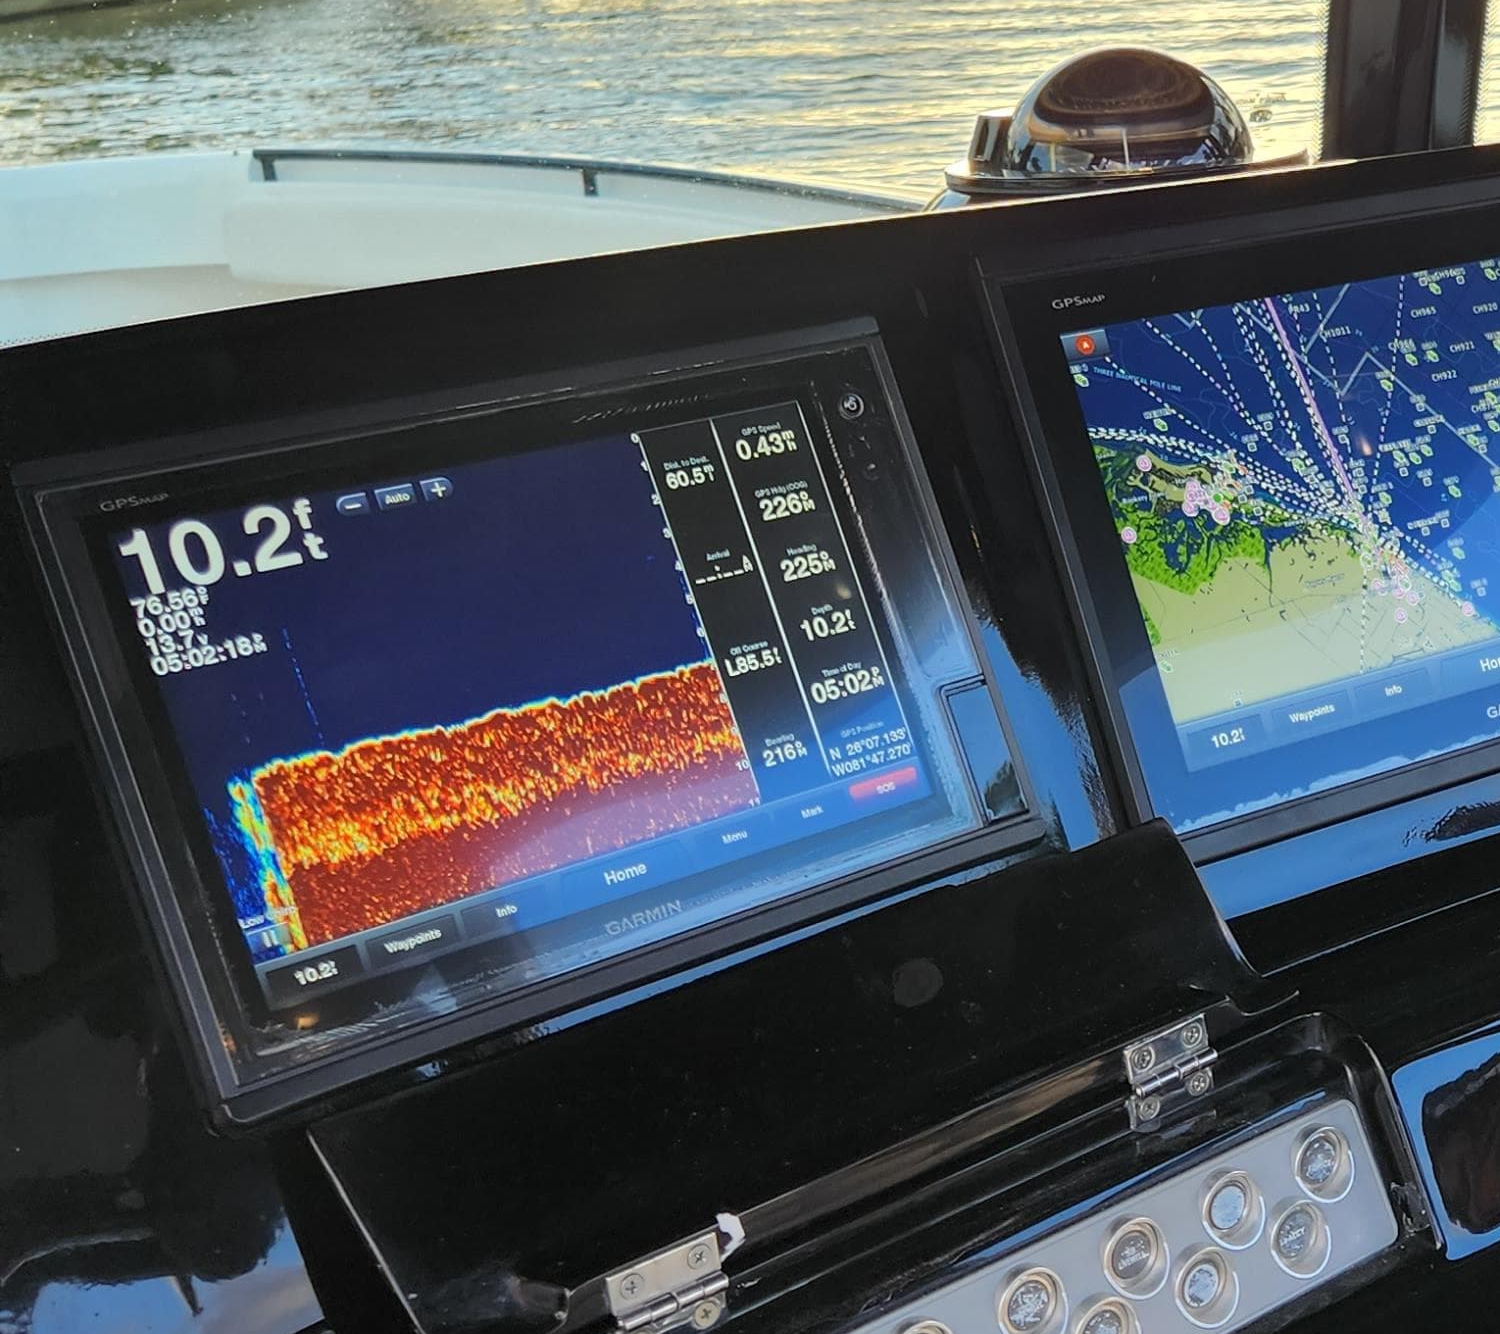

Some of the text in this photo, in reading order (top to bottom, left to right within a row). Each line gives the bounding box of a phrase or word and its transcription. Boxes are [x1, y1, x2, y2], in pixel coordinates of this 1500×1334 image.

[741, 422, 781, 437] GPS Speed
[735, 431, 783, 461] 0.43
[665, 466, 705, 490] 60.5
[385, 490, 411, 505] Auto
[118, 505, 304, 596] 10.2
[129, 589, 201, 619] 76.56
[137, 612, 190, 639] 0.00
[800, 611, 849, 641] 10.2
[724, 649, 775, 677] L85.5
[821, 666, 838, 678] Time
[847, 661, 862, 675] Day
[810, 669, 873, 704] 05:02
[1211, 728, 1243, 749] 10.2
[1289, 703, 1335, 724] Waypoints
[736, 759, 750, 772] 10
[829, 746, 842, 762] N
[293, 782, 896, 987] 10.2 Waypoints Info Home Menu Mark SOS
[604, 899, 683, 937] GARMIN
